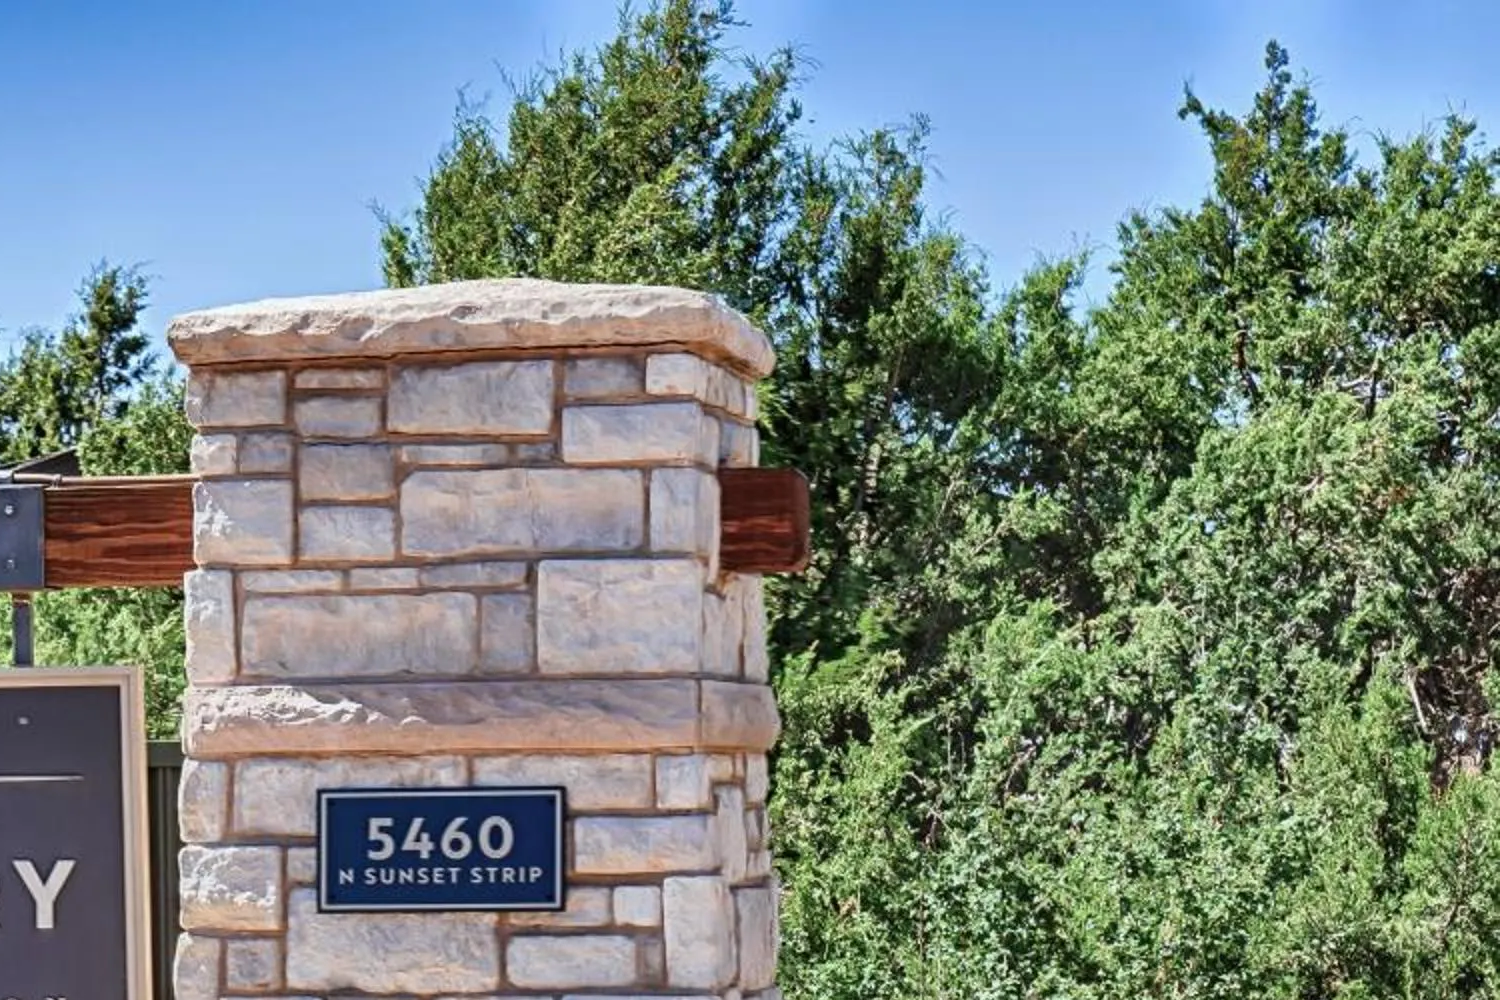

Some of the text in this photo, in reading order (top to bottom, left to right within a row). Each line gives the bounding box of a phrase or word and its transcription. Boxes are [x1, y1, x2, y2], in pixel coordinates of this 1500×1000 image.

[367, 815, 514, 860] 5460
[339, 866, 543, 885] N SUNSET STRIP
